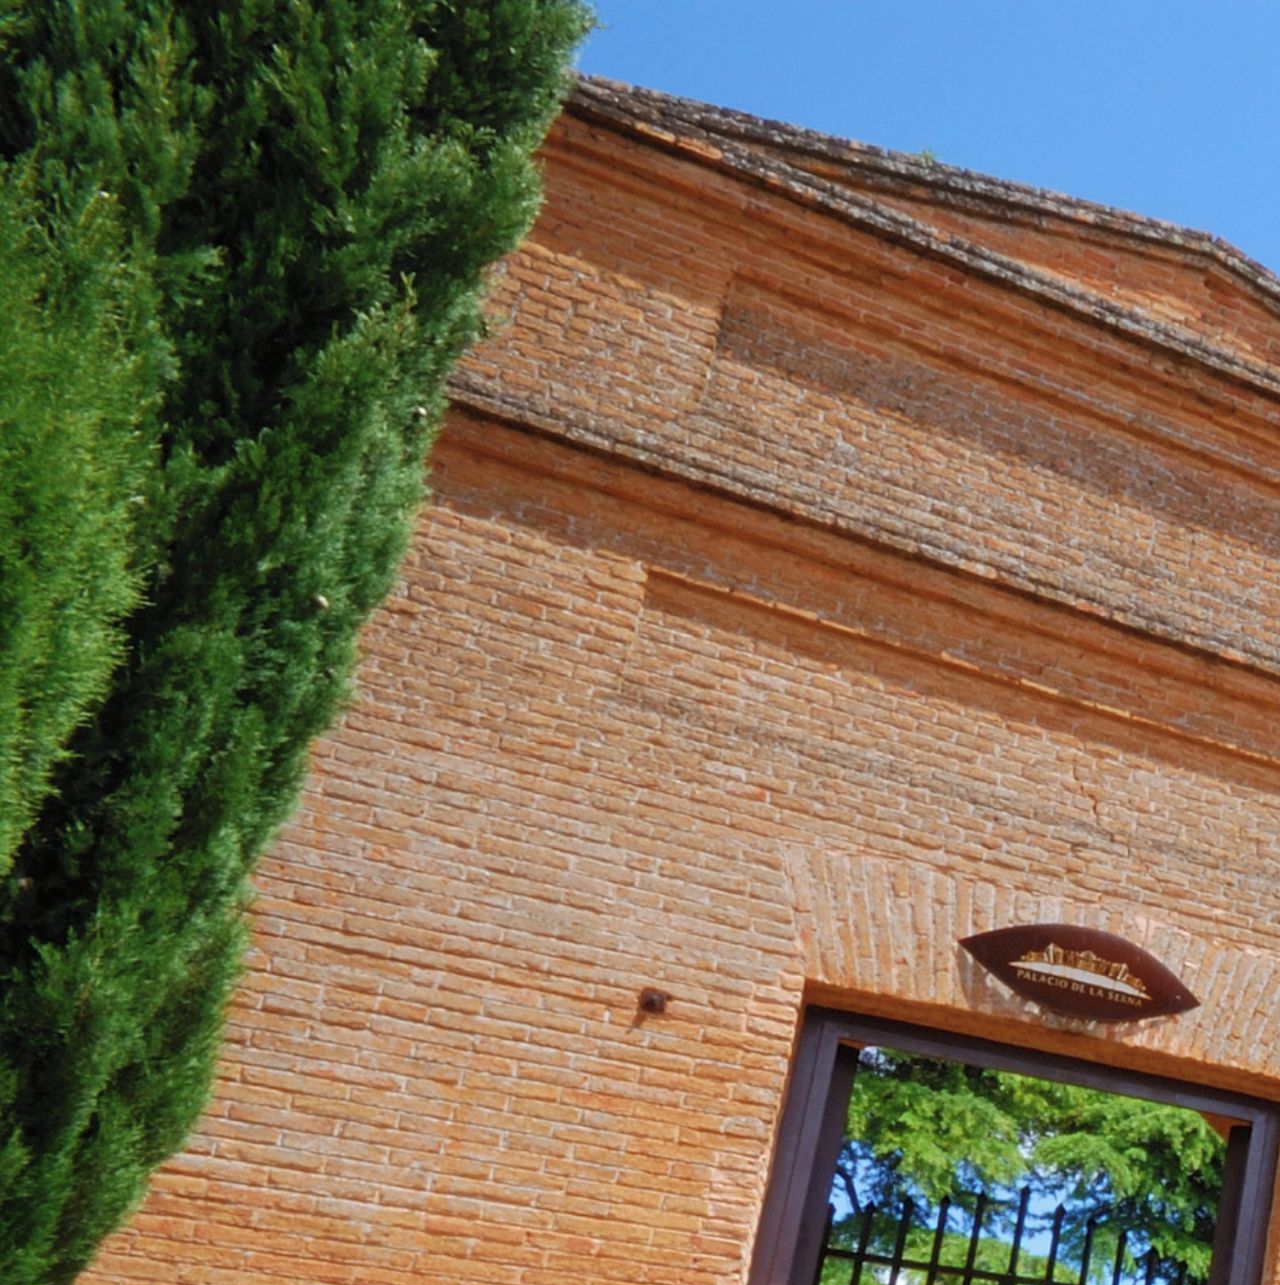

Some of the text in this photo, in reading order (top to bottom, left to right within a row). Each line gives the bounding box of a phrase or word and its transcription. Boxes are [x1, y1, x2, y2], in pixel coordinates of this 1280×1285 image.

[1016, 969, 1143, 1008] PALACIO DE LA SERNA
